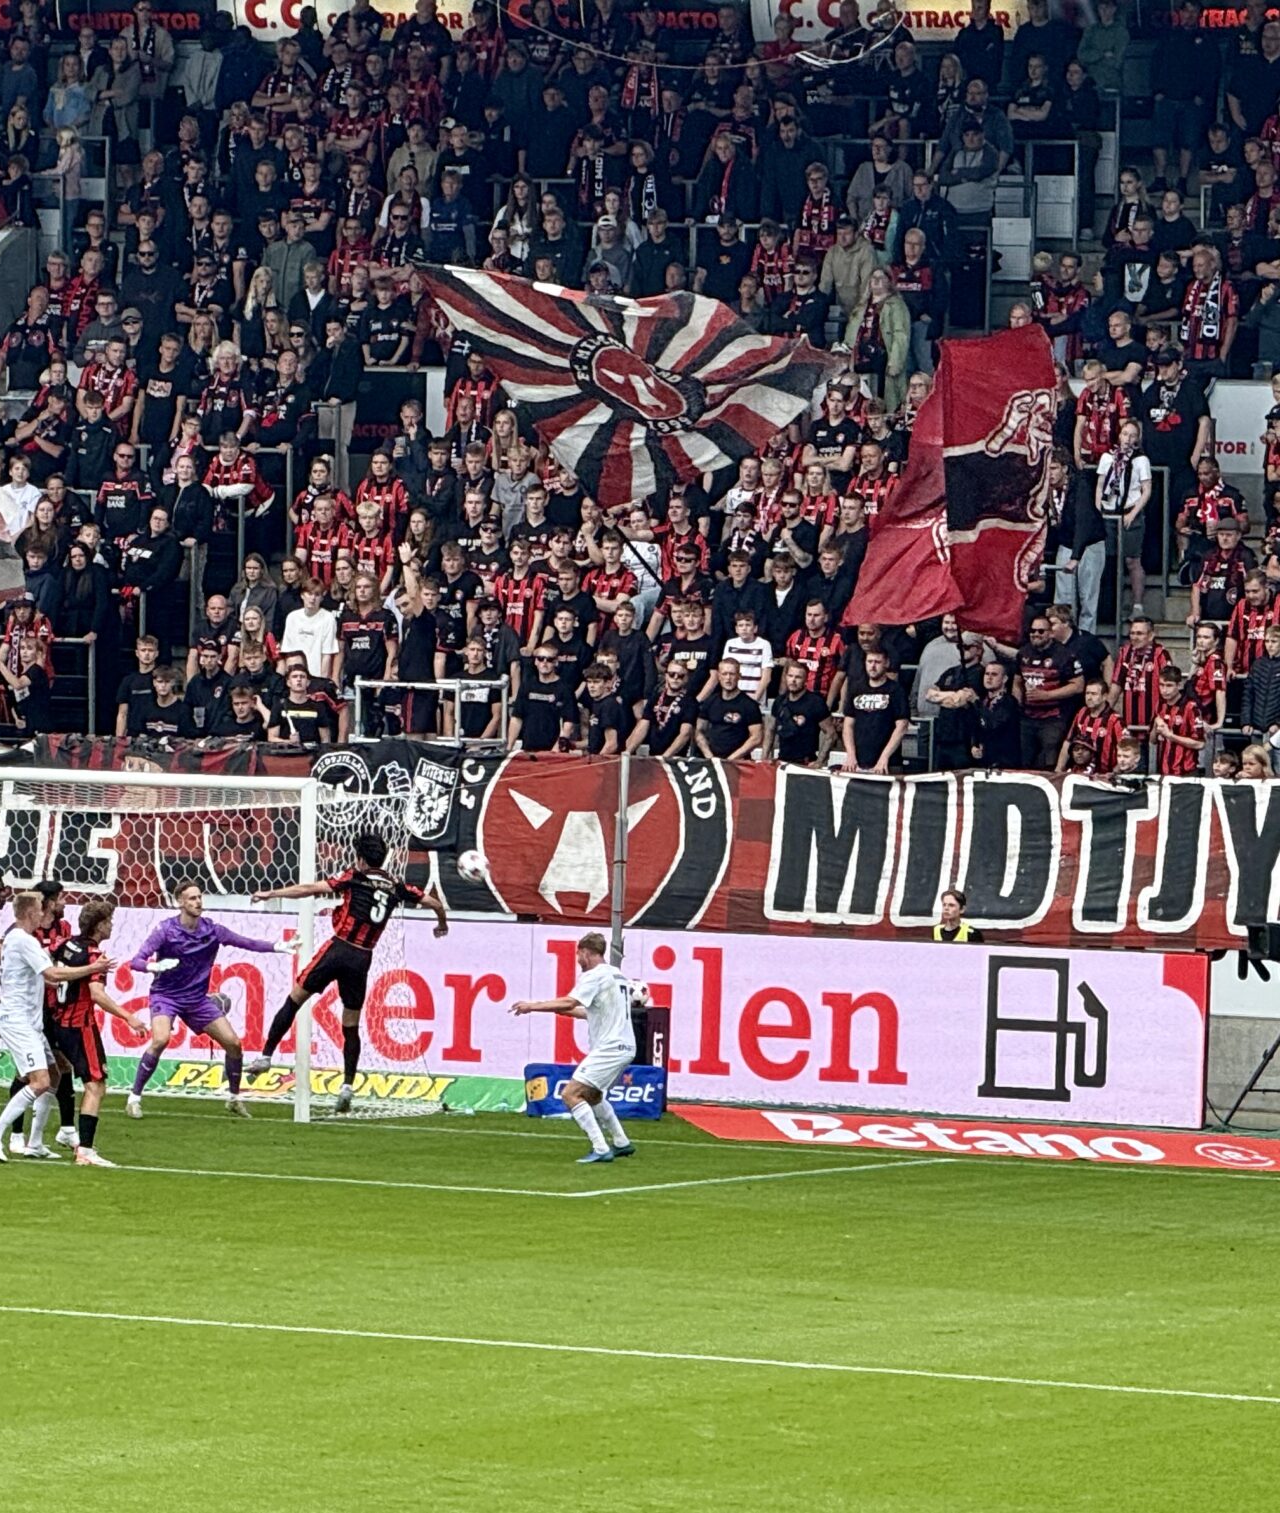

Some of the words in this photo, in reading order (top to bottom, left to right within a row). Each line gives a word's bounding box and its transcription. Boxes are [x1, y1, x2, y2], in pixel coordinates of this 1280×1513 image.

[420, 762, 457, 786] VITESSE
[370, 889, 389, 924] 3
[26, 1052, 35, 1067] 5
[760, 1110, 1166, 1162] Betano
